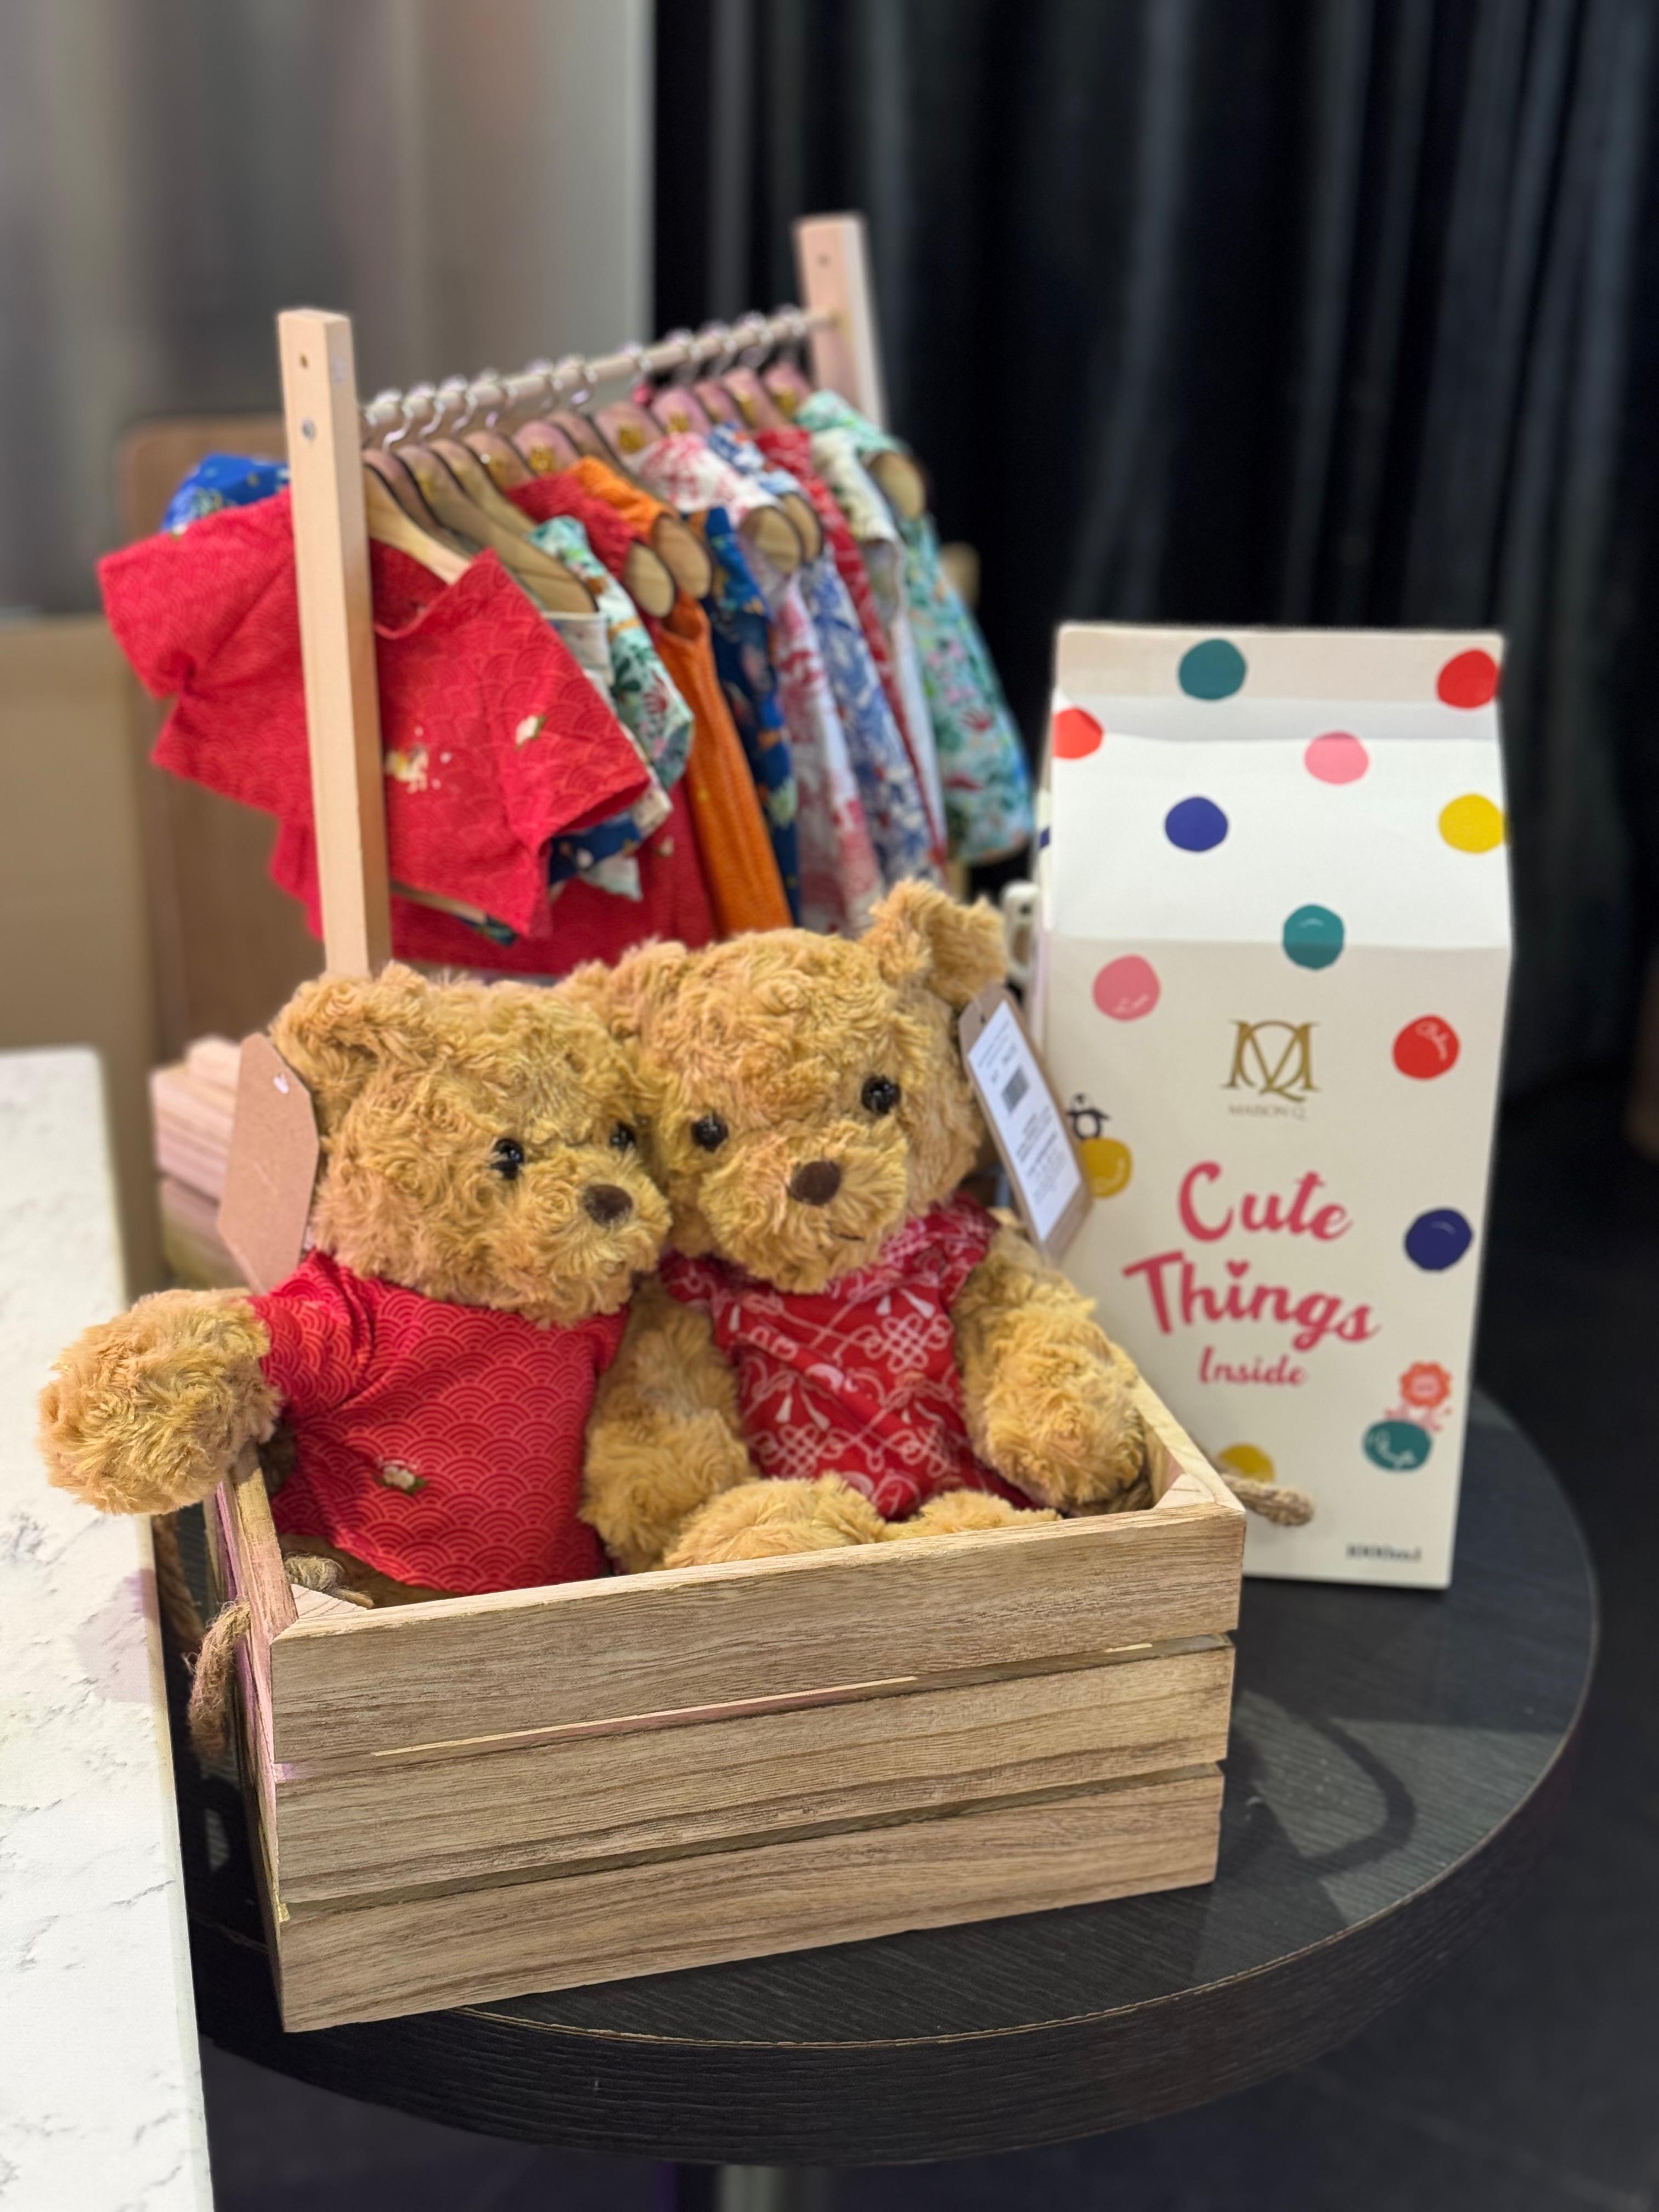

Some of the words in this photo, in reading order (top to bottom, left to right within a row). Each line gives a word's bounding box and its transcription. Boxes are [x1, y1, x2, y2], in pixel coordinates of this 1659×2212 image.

[1178, 1161, 1353, 1243] Cute
[1121, 1250, 1381, 1351] Things
[1199, 1346, 1307, 1386] Inside
